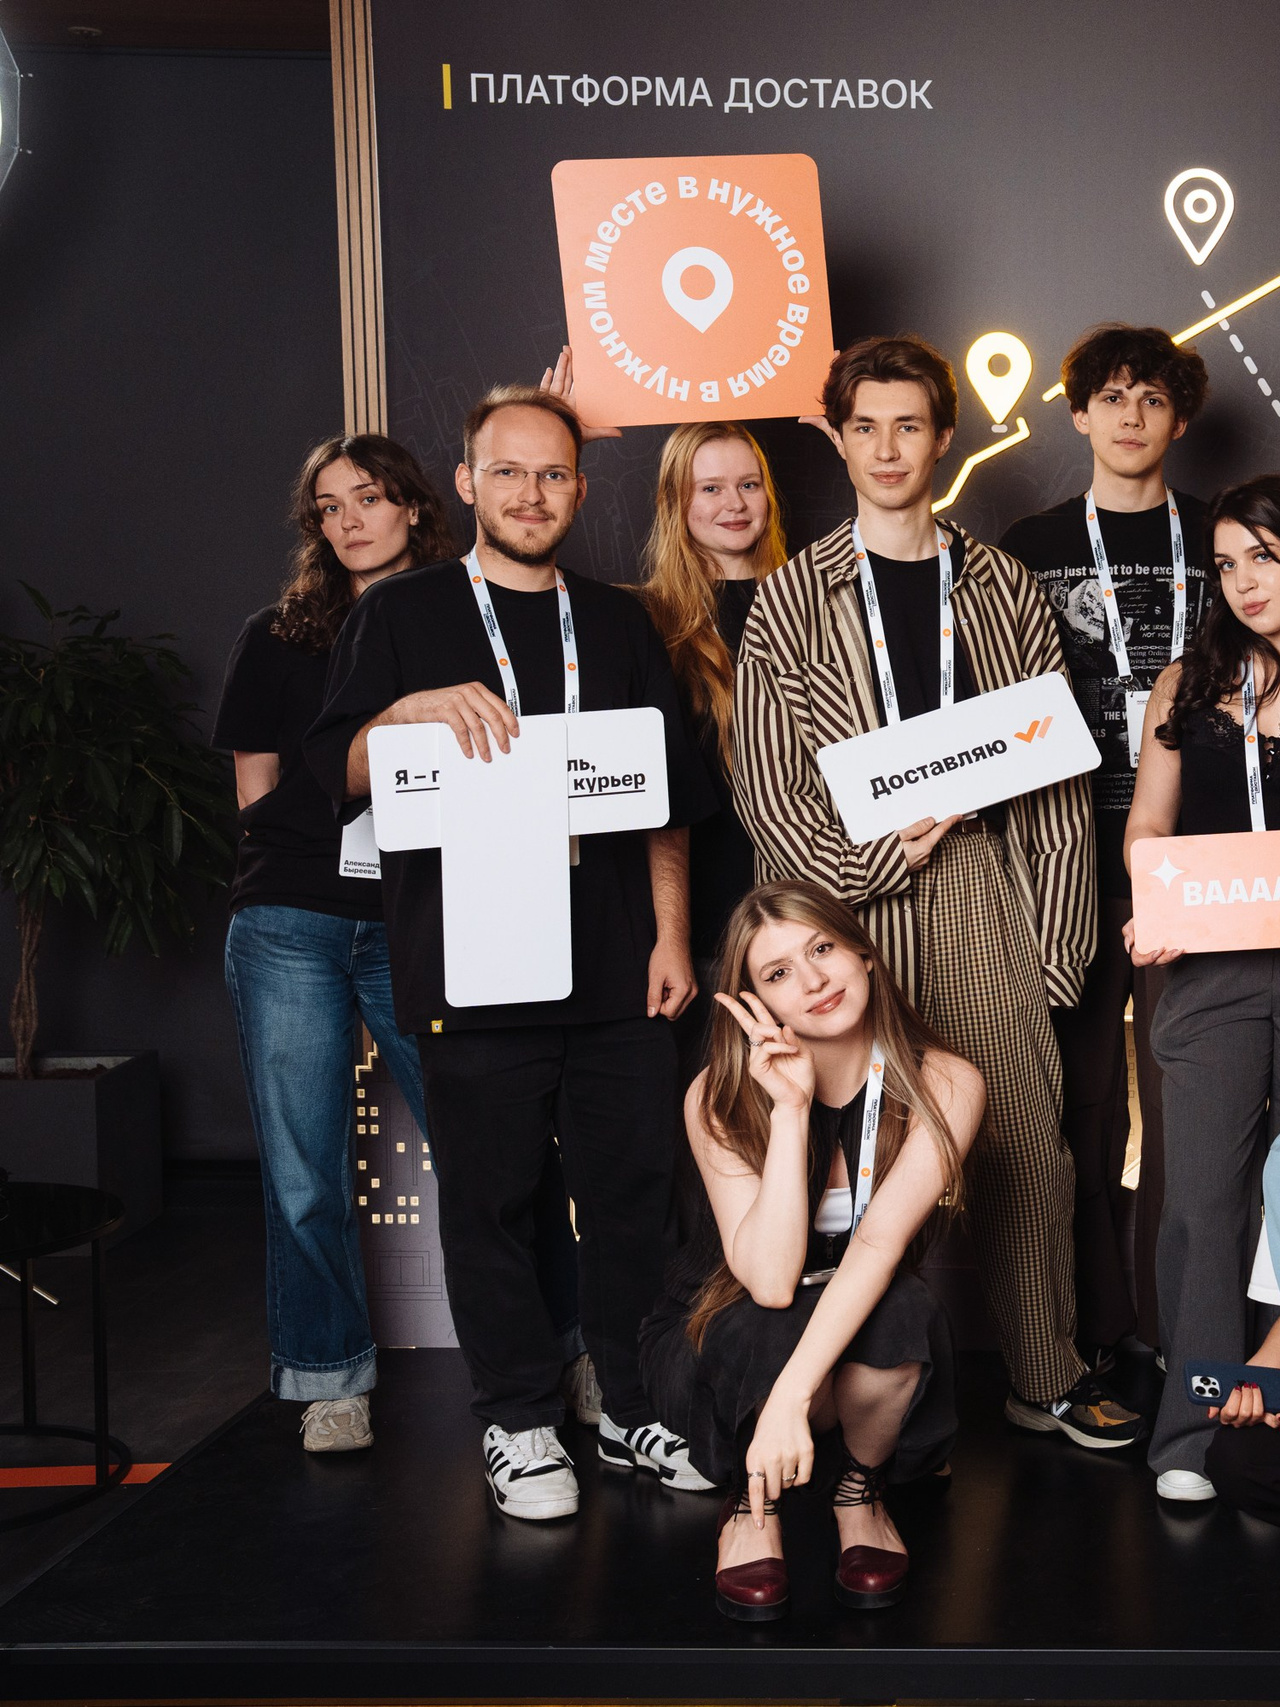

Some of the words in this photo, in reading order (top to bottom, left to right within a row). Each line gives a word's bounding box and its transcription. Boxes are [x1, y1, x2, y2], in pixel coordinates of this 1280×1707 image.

[470, 73, 713, 107] ПЛАТФОРМА
[724, 77, 933, 113] ДОСТАВОК
[678, 176, 699, 198] в
[584, 180, 667, 273] месте
[708, 178, 810, 293] нужное
[584, 281, 689, 402] нужном
[731, 304, 810, 399] время
[700, 381, 720, 403] в
[1032, 568, 1062, 581] Teens
[1064, 566, 1087, 579] just
[1089, 564, 1118, 576] wnt
[1121, 564, 1132, 575] to
[1135, 563, 1150, 575] be
[1104, 711, 1120, 720] THE
[395, 770, 408, 785] Я
[869, 739, 1008, 800] Доставляю
[573, 773, 646, 793] курьер
[344, 860, 380, 869] Александ
